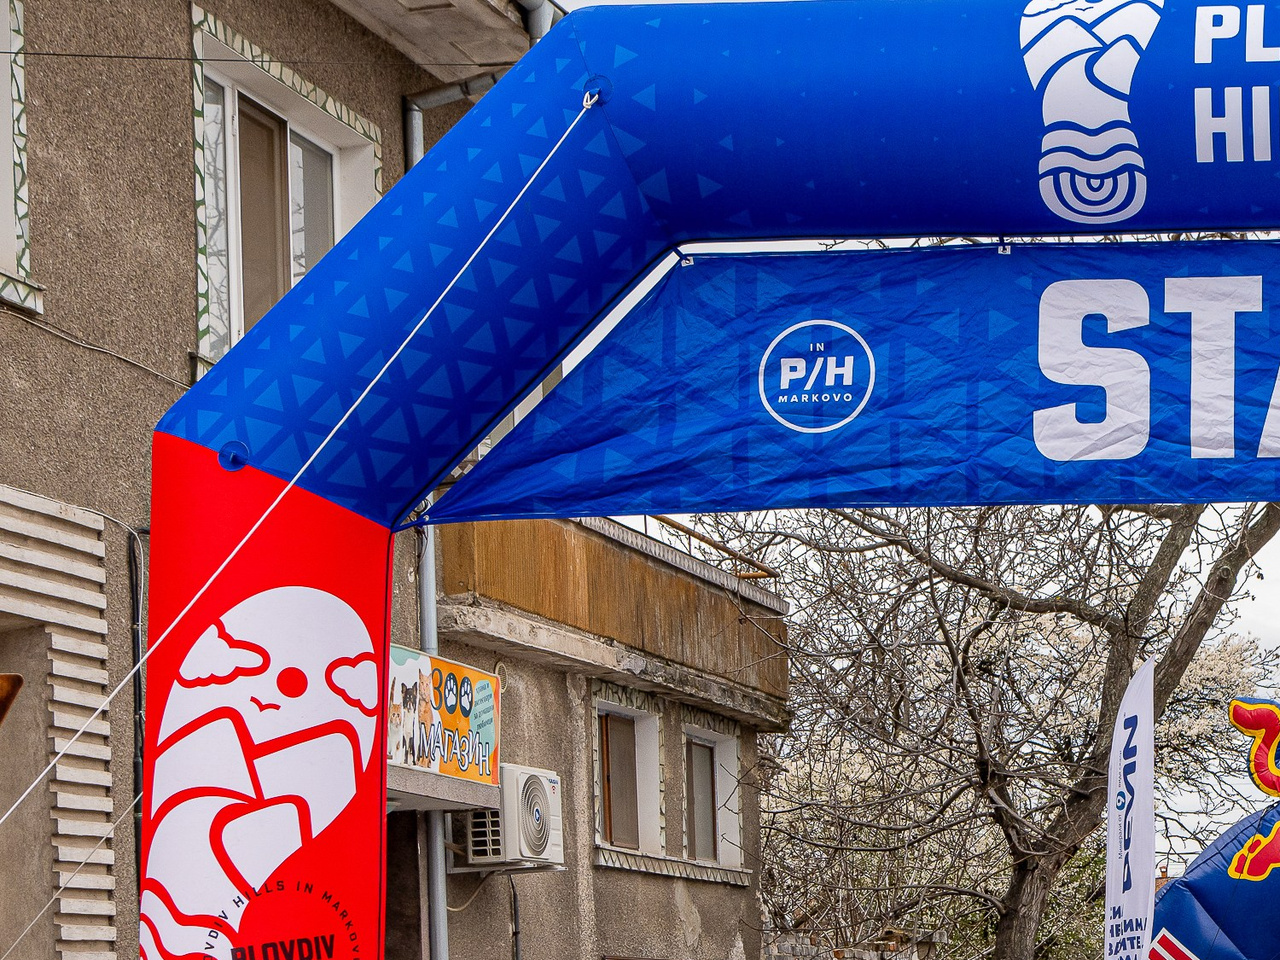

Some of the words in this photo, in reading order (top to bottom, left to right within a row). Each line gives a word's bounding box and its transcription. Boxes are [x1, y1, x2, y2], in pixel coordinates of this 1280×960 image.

[809, 342, 825, 352] IN
[780, 355, 855, 391] P/H
[777, 393, 853, 403] MARKOVO
[418, 720, 492, 777] МАГАЗИН
[232, 880, 285, 908] HILLS
[296, 880, 314, 895] IN
